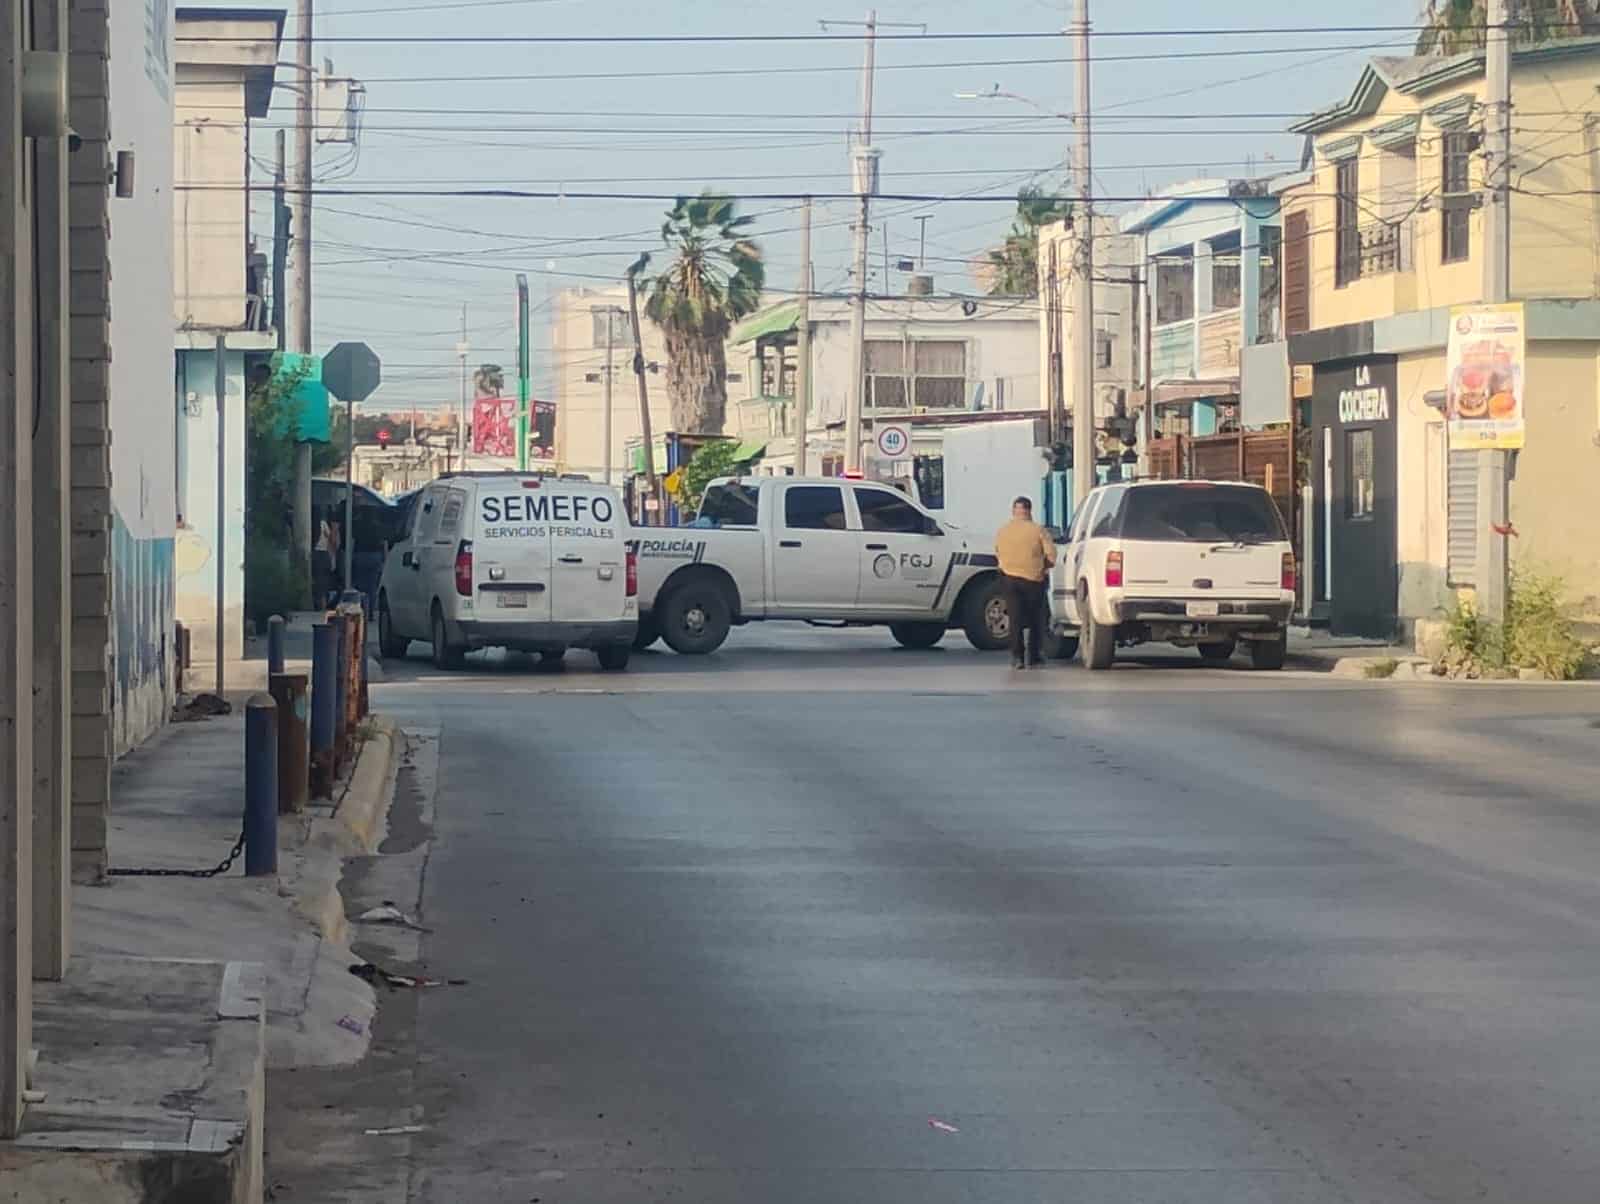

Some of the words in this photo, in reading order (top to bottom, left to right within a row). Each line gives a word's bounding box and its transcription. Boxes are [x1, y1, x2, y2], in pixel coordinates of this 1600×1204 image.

[1356, 365, 1370, 386] LA
[1339, 387, 1389, 423] COCHERA
[886, 433, 900, 445] 40
[482, 495, 613, 522] SEMEFO
[484, 526, 546, 538] SERVICIOS
[550, 526, 615, 539] PERICIALES
[641, 538, 694, 552] POLICÍA
[900, 553, 933, 568] FGJ
